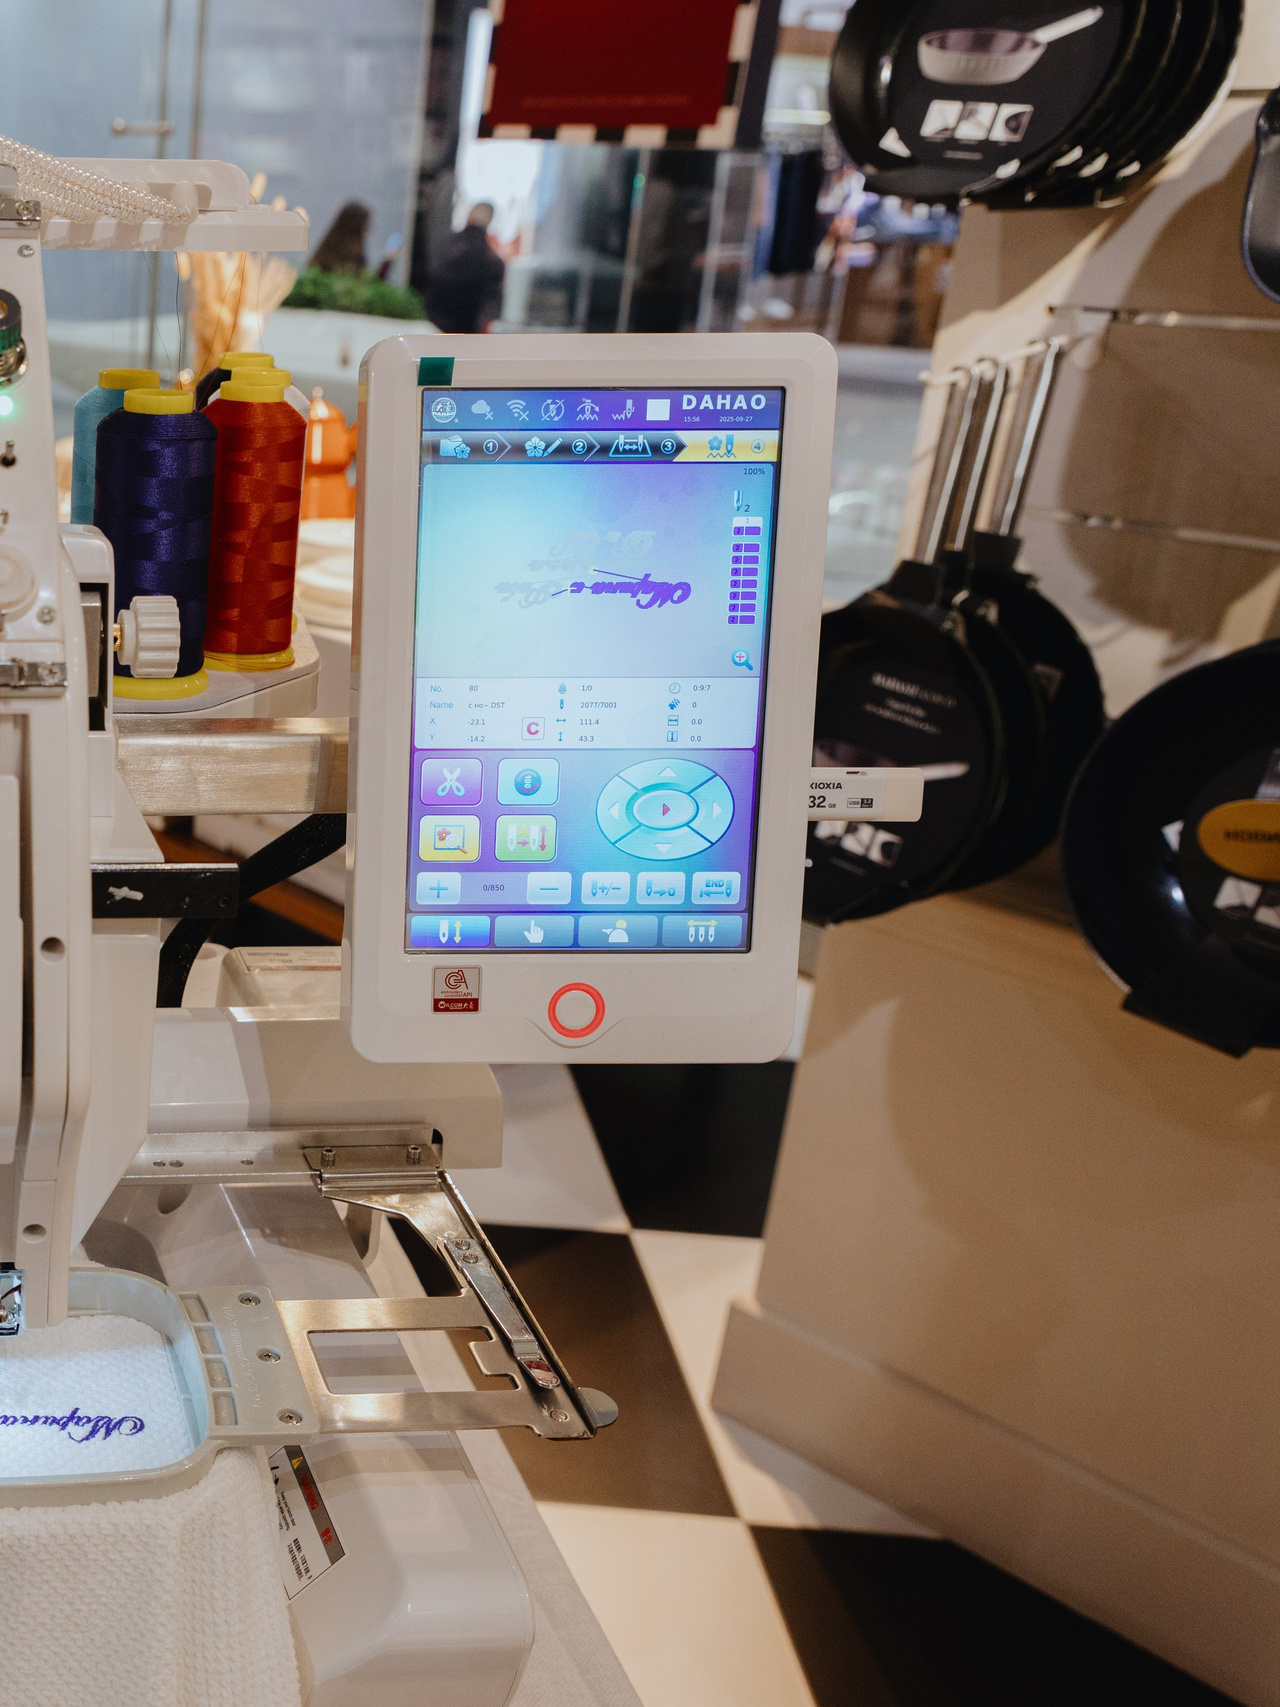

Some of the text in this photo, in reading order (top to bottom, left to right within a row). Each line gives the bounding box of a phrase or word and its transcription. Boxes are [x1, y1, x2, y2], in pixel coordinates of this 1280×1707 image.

[682, 394, 766, 410] DAHAO
[693, 684, 710, 692] 0:9:7
[468, 718, 485, 726] -23.1
[526, 722, 540, 736] C
[524, 775, 532, 788] 100
[809, 796, 826, 808] 32
[482, 884, 505, 892] 0/850
[706, 880, 724, 888] END
[302, 1476, 319, 1510] WARNING
